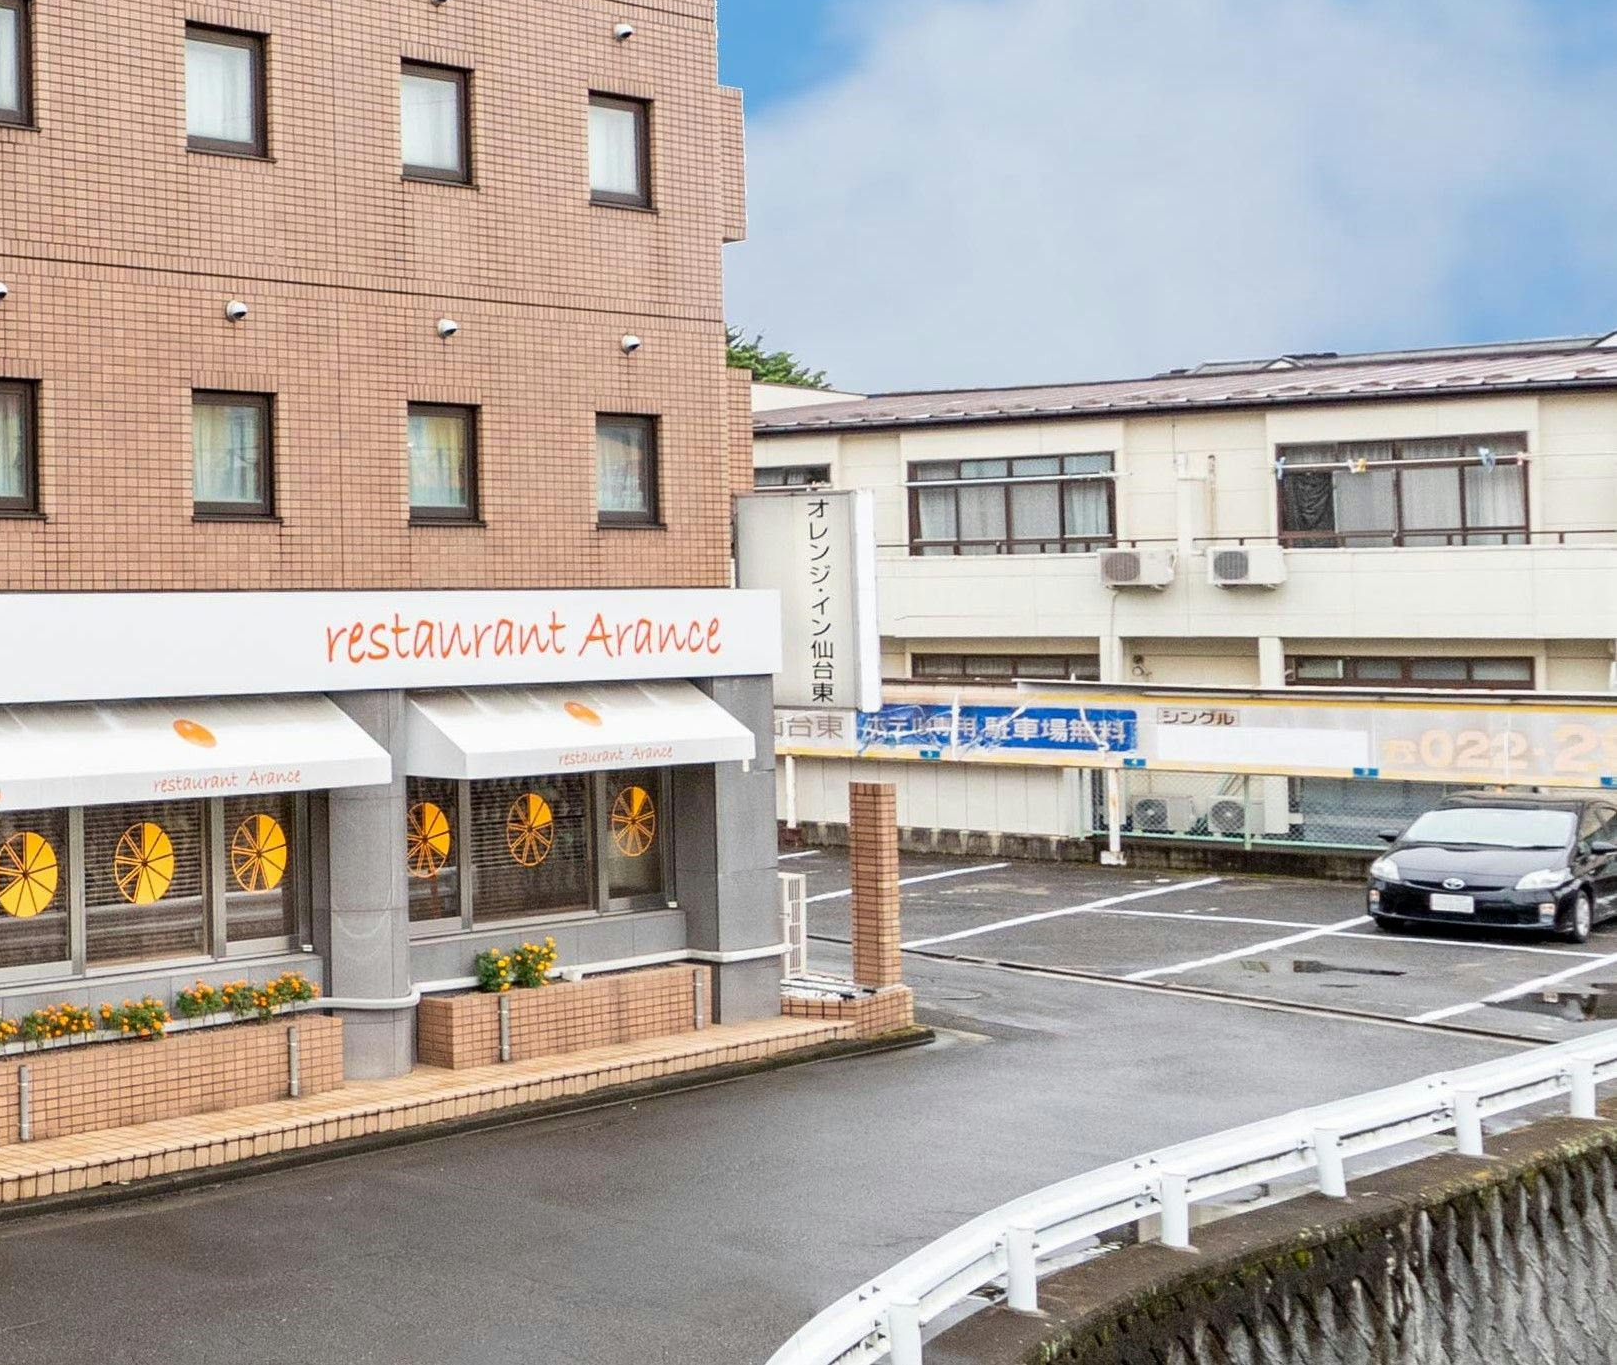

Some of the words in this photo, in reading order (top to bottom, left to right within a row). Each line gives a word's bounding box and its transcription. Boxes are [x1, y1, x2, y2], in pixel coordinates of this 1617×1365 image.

[807, 498, 835, 703] オレンジ・イン仙台東
[325, 611, 567, 664] restaurant
[577, 612, 724, 659] Arance
[557, 748, 628, 767] restaurant
[630, 746, 674, 761] Arance
[152, 771, 239, 794] restaurant
[246, 768, 303, 788] Arance
